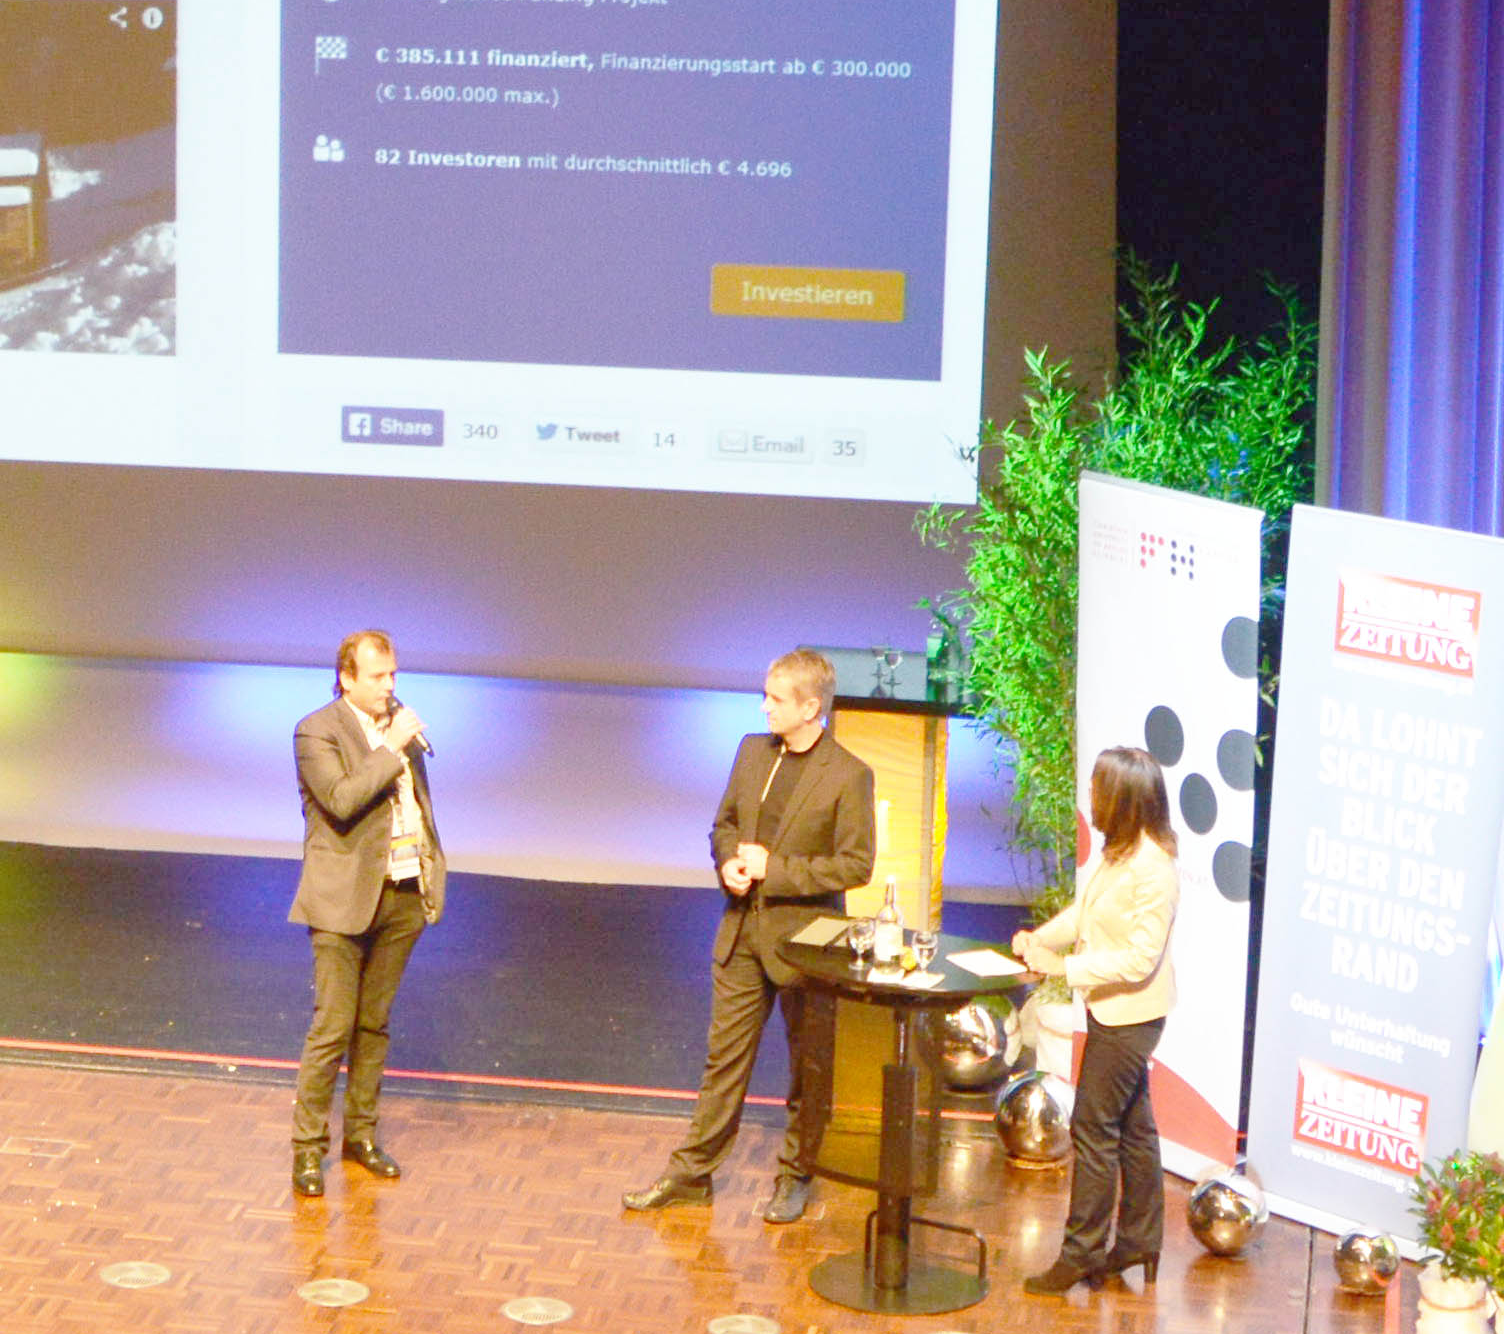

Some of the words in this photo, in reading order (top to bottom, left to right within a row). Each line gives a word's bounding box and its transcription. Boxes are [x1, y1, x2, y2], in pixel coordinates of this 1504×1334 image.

[376, 47, 390, 65] €
[396, 47, 481, 67] 385.111
[486, 47, 595, 71] finanziert,
[601, 51, 777, 80] Finanzierungsstart
[783, 57, 806, 75] ab
[812, 60, 825, 77] €
[831, 60, 911, 79] 300.000
[376, 82, 396, 105] (€
[403, 84, 498, 105] 1.600.000
[504, 85, 561, 108] max.)
[375, 147, 401, 166] 82
[408, 149, 521, 170] Investoren
[527, 151, 558, 171] mit
[565, 152, 711, 176] durchschnittlich
[718, 159, 731, 176] €
[737, 159, 793, 178] 4.696
[742, 281, 874, 308] Investieren
[380, 419, 433, 438] Share
[462, 423, 498, 441] 340
[565, 426, 621, 444] Tweet
[653, 432, 676, 449] 14
[752, 436, 805, 455] Email
[832, 440, 857, 458] 35
[1339, 620, 1473, 670] ZEITUNG
[1320, 695, 1361, 744] DA
[1372, 707, 1483, 768] LOHNT
[1319, 742, 1392, 797] SICH
[1402, 763, 1468, 815] DER
[1341, 797, 1437, 856] BLICK
[1306, 826, 1390, 892] ÜBER
[1398, 858, 1464, 910] DEN
[1300, 879, 1471, 957] ZEITUNGS-
[1331, 934, 1418, 994] RAND
[1290, 991, 1330, 1019] Gute
[1335, 1003, 1451, 1058] Unterhaltung
[1330, 1028, 1404, 1064] wünscht
[1302, 1068, 1424, 1135] KLEINE
[1298, 1112, 1419, 1170] ZEITUNG
